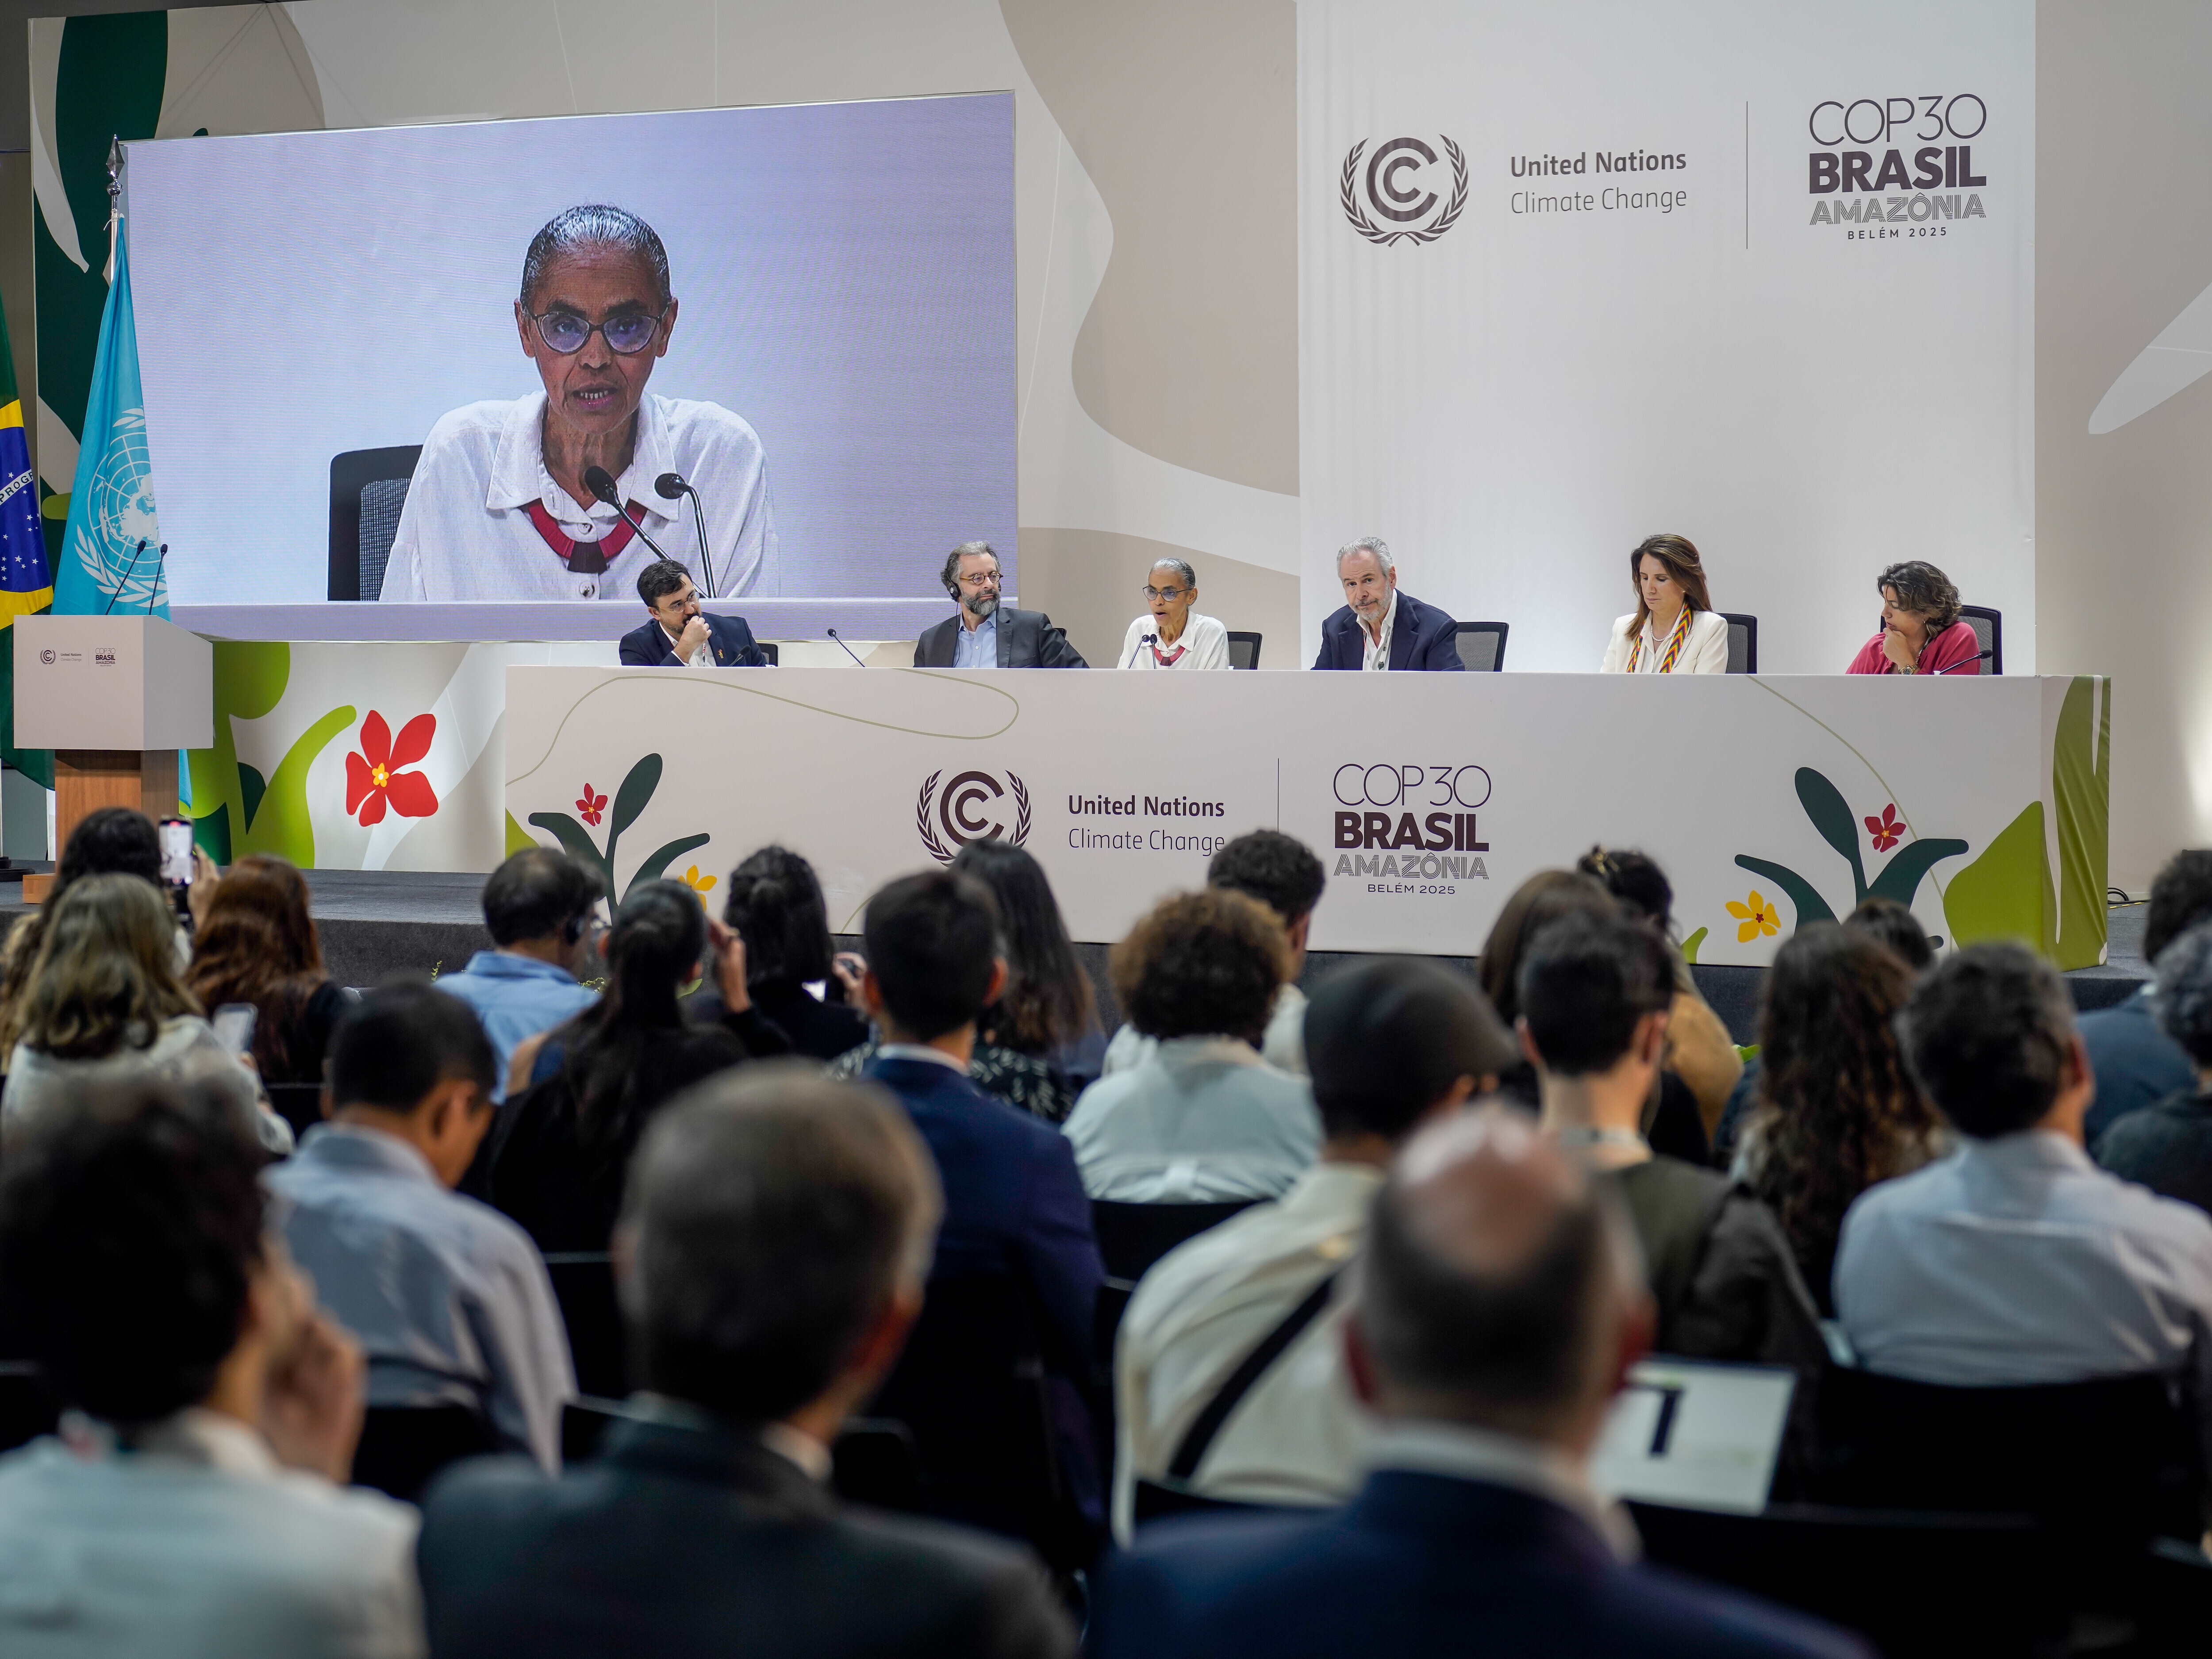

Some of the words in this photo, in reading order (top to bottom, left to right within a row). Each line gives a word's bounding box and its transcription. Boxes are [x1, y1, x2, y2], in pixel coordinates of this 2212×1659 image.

[1809, 93, 1987, 146] COP30
[1511, 152, 1586, 177] United
[1596, 149, 1686, 173] Nations
[1809, 145, 1987, 194] BRASIL
[1512, 191, 1594, 214] Climate
[1602, 186, 1687, 213] Change
[1809, 192, 1986, 226] AMAZÔNIA
[1847, 227, 1899, 240] BELÉM
[1909, 227, 1947, 238] 2025
[1333, 764, 1492, 808] COP30
[1068, 795, 1135, 816] United
[1144, 796, 1225, 818] Nations
[1068, 828, 1142, 850] Climate
[1149, 829, 1225, 856] Change
[1334, 811, 1490, 852] BRASIL
[1333, 852, 1490, 880] AMAZÔNIA
[1367, 882, 1414, 894] BELÉM
[1419, 885, 1455, 894] 2025
